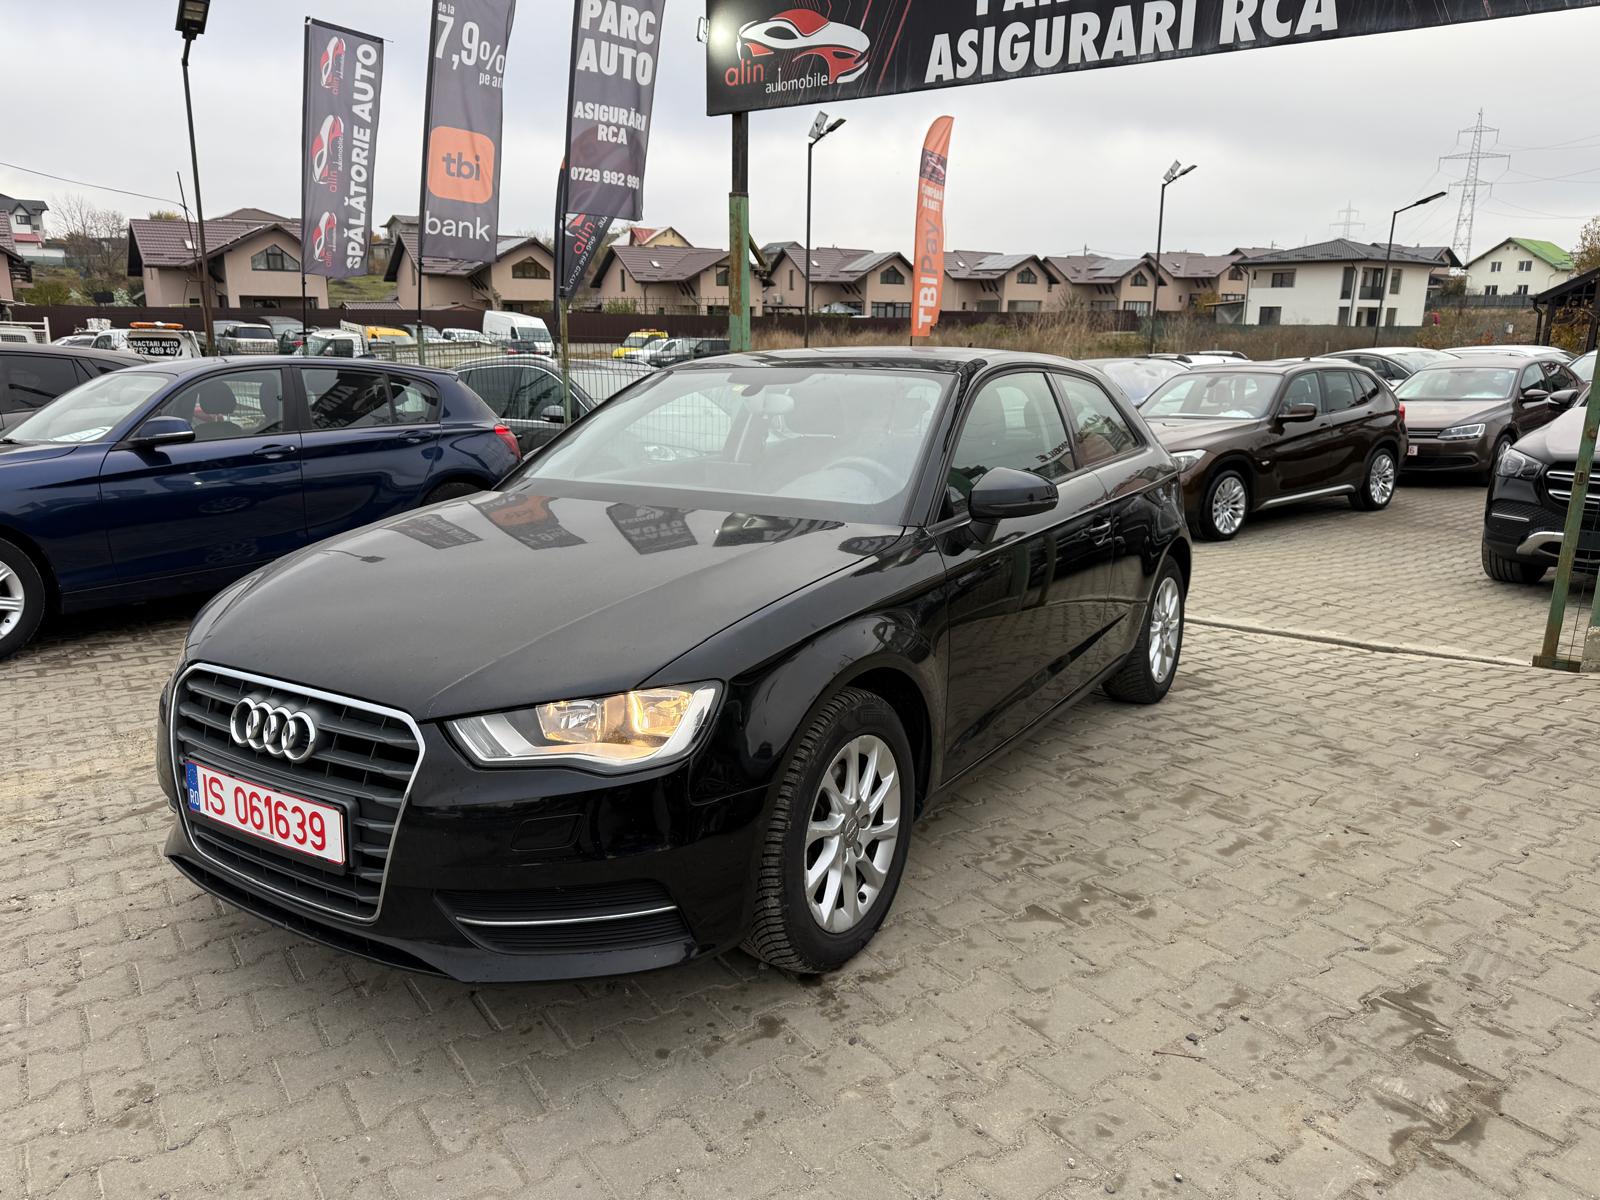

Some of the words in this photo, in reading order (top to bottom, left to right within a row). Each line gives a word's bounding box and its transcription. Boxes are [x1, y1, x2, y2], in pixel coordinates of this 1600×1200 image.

[447, 3, 455, 15] la
[580, 0, 656, 45] PARC
[435, 13, 505, 74] 7,9%
[924, 1, 1196, 84] ASIGURARI
[1219, 0, 1338, 45] RCA
[576, 37, 654, 86] AUTO
[724, 58, 765, 87] alin
[352, 43, 377, 123] AUTO
[479, 72, 490, 86] pe
[765, 67, 829, 94] automobile
[573, 100, 647, 132] ASIGURĂRI
[597, 123, 628, 145] RCA
[328, 170, 337, 193] alin
[442, 151, 481, 181] tbi
[570, 166, 600, 183] 0729
[602, 170, 625, 187] 992
[344, 125, 371, 269] SPĂLĂTORIE
[425, 210, 490, 243] bank
[573, 221, 596, 255] alin
[150, 346, 165, 355] 489
[189, 788, 200, 806] RO
[202, 773, 226, 816] IS
[234, 786, 326, 851] 061639
